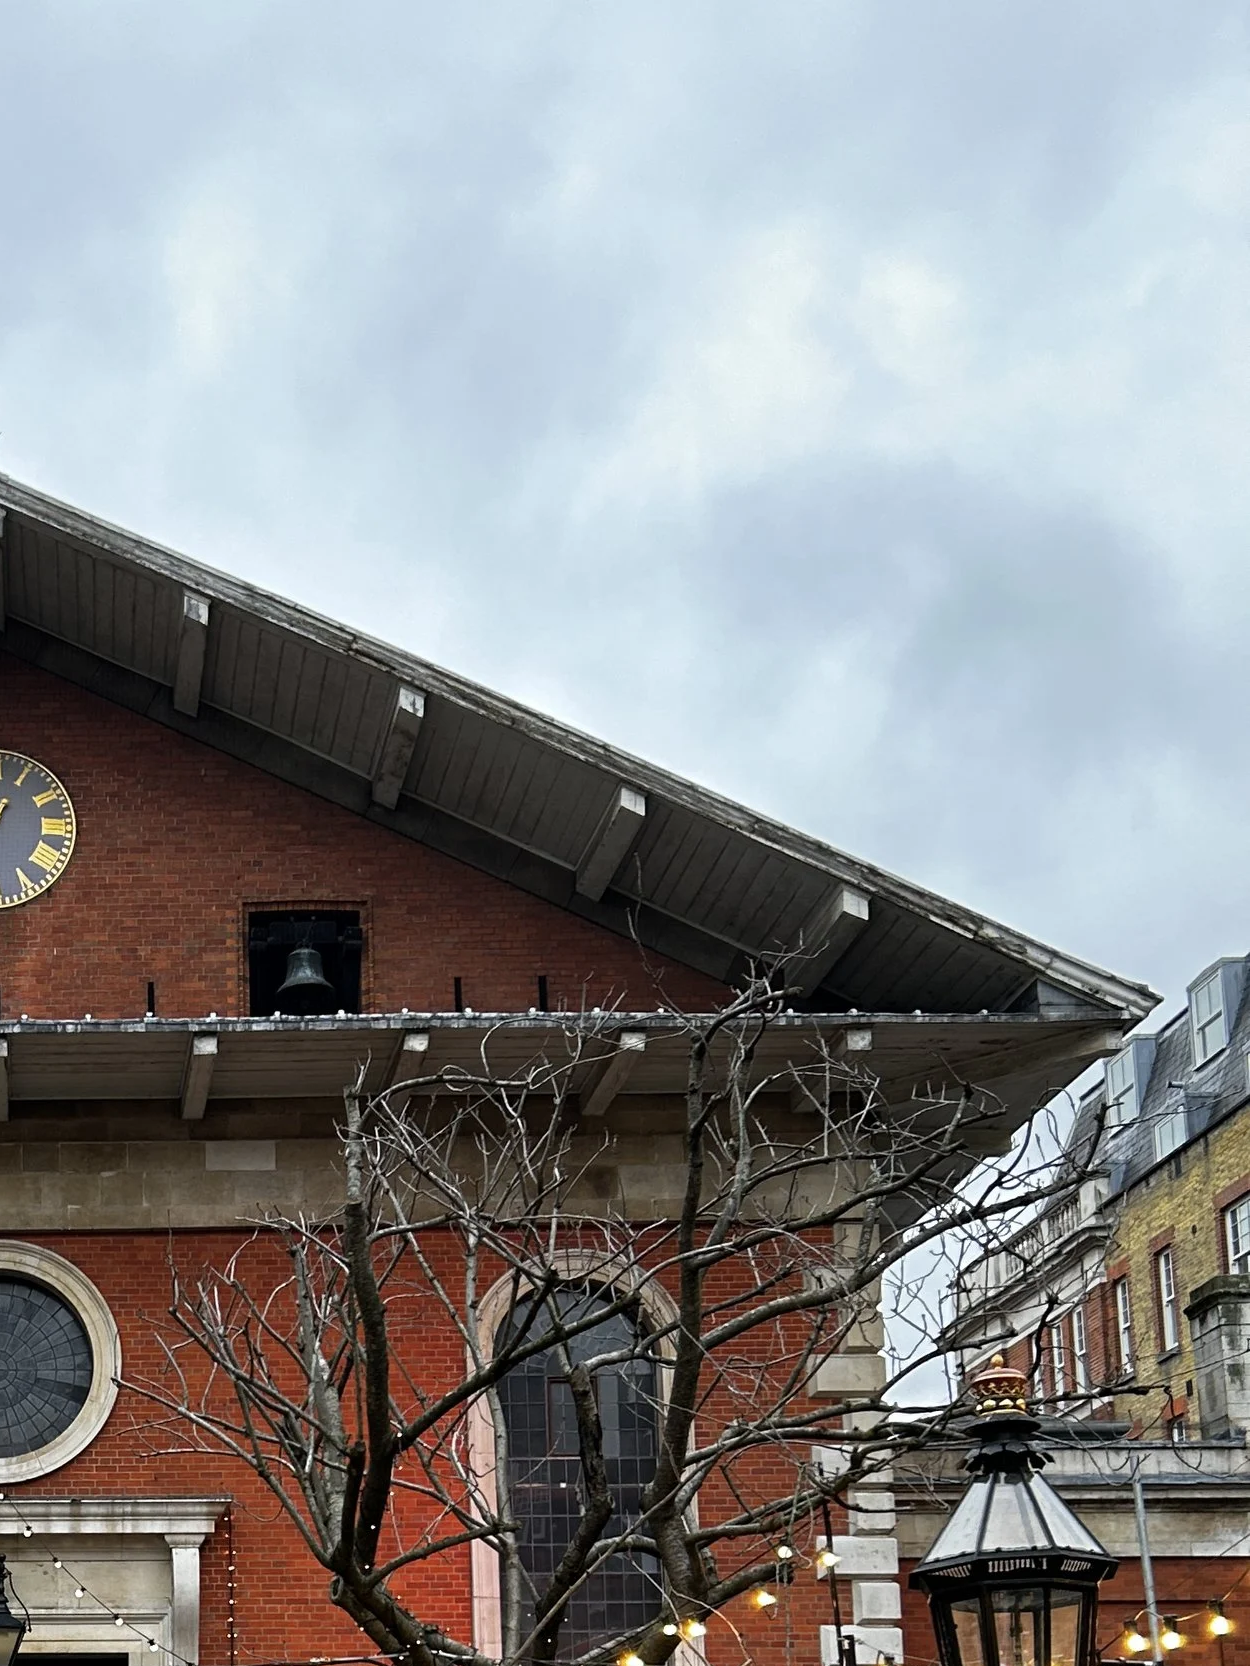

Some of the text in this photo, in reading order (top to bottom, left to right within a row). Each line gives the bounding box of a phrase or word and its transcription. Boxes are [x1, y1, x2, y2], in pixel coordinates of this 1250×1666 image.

[14, 766, 31, 787] I
[32, 789, 58, 808] II
[41, 816, 66, 837] III
[28, 840, 61, 873] IIII
[16, 867, 35, 892] V
